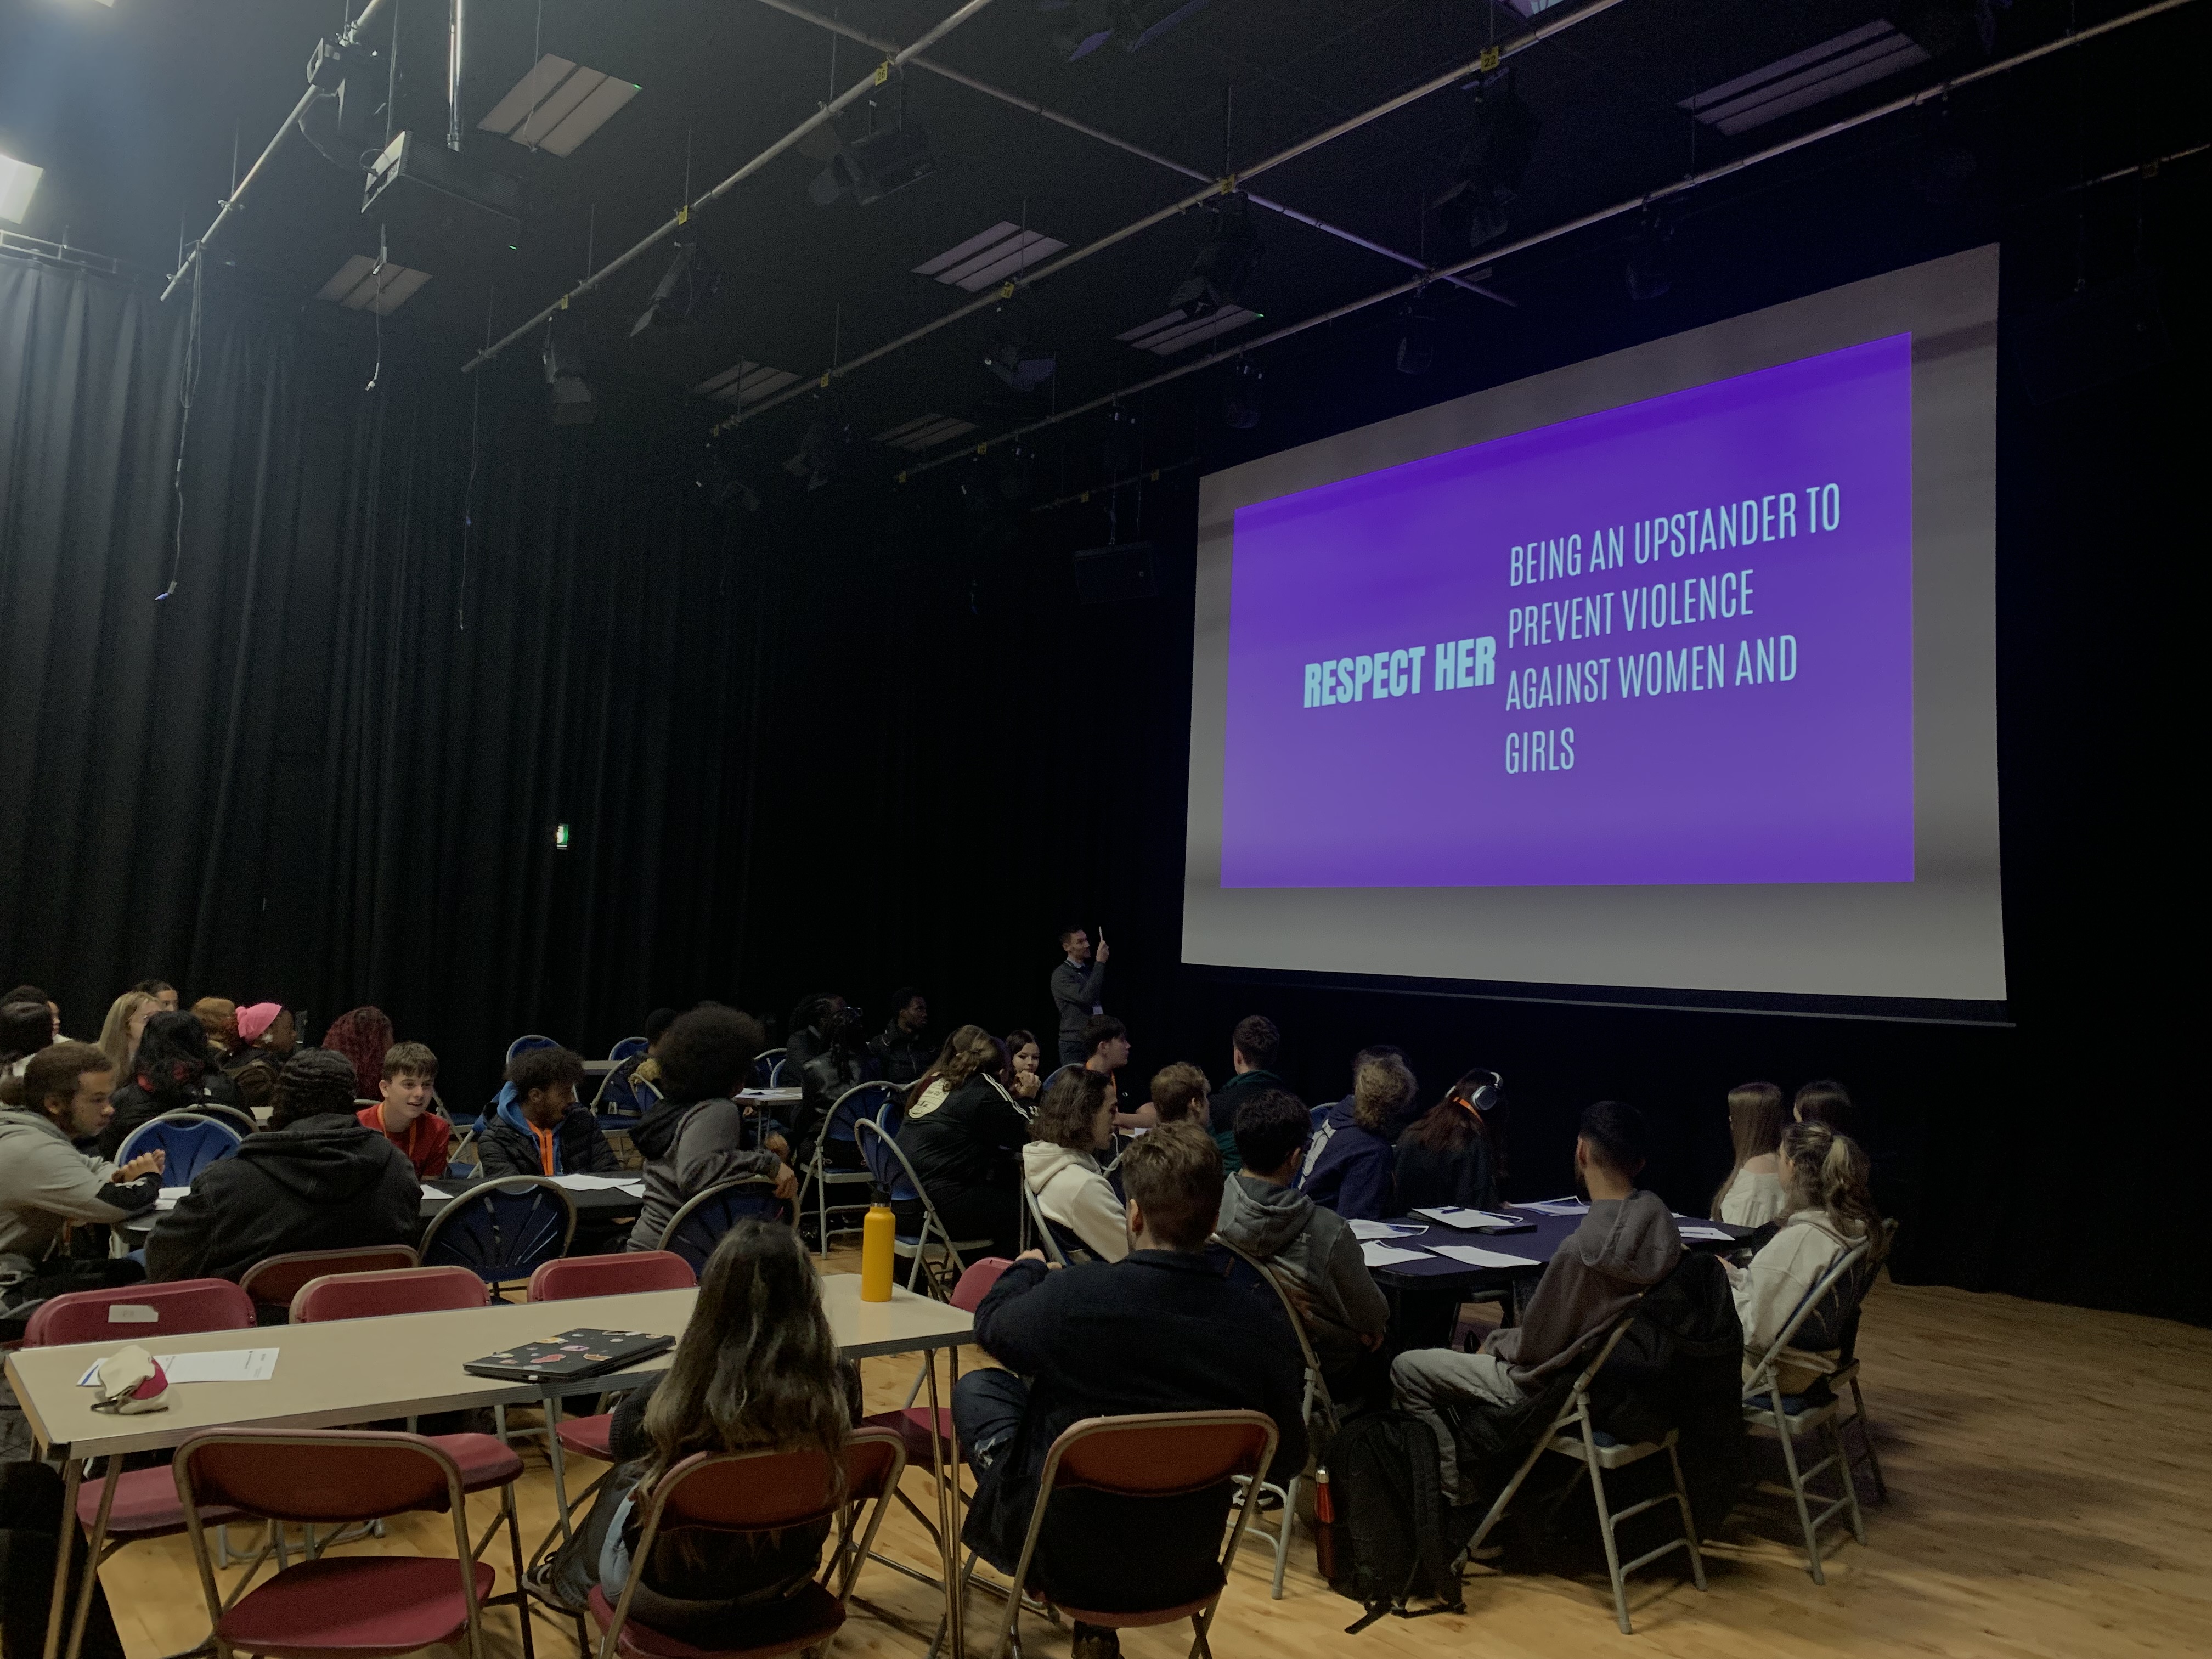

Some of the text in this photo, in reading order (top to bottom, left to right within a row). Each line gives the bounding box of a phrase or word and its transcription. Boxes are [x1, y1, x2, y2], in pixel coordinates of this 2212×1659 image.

[878, 70, 885, 81] 26
[1485, 55, 1496, 67] 22
[1510, 483, 1840, 587] BEING AN UPSTANDER TO
[1509, 569, 1753, 649] PREVENT VIOLENCE
[1304, 636, 1496, 708] RESPECT HER
[1505, 635, 1797, 712] AGAINST WOMEN AND
[1505, 727, 1575, 774] GIRLS
